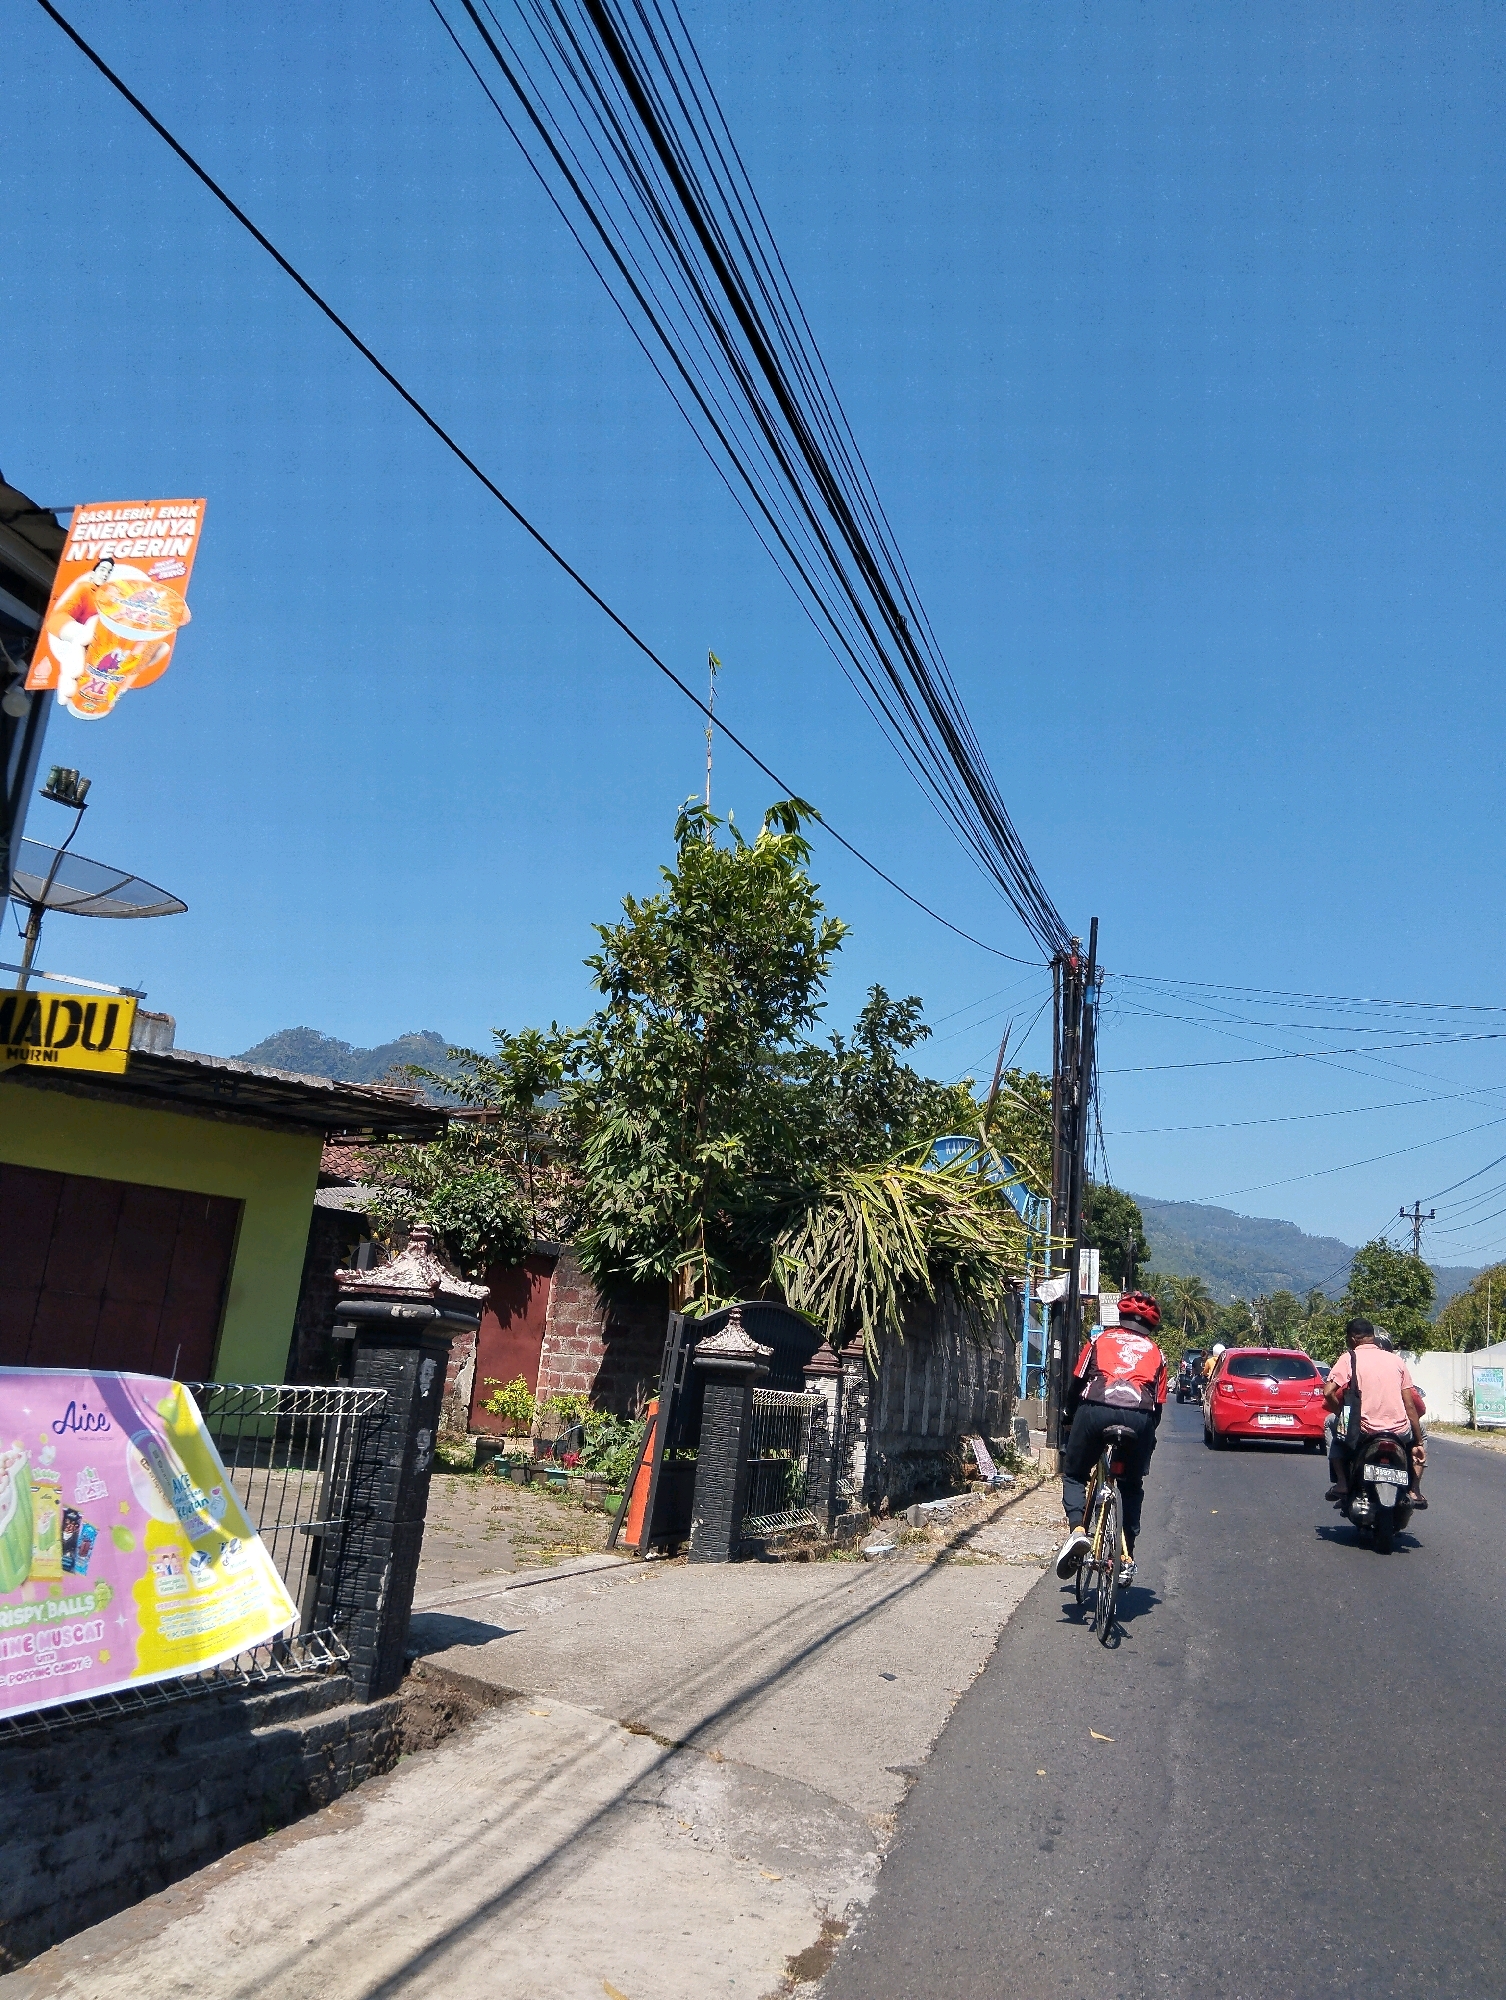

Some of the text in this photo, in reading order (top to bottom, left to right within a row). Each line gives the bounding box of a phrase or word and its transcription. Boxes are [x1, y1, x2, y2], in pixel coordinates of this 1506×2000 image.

[76, 506, 200, 524] RASA LEBIH ENAK
[71, 519, 196, 541] ENERGINYA
[65, 538, 193, 561] NYEGERIN
[6, 1048, 59, 1063] MURNI
[52, 1401, 111, 1434] Aice
[47, 1595, 95, 1618] BALLS
[0, 1620, 104, 1659] INE MUSCAT
